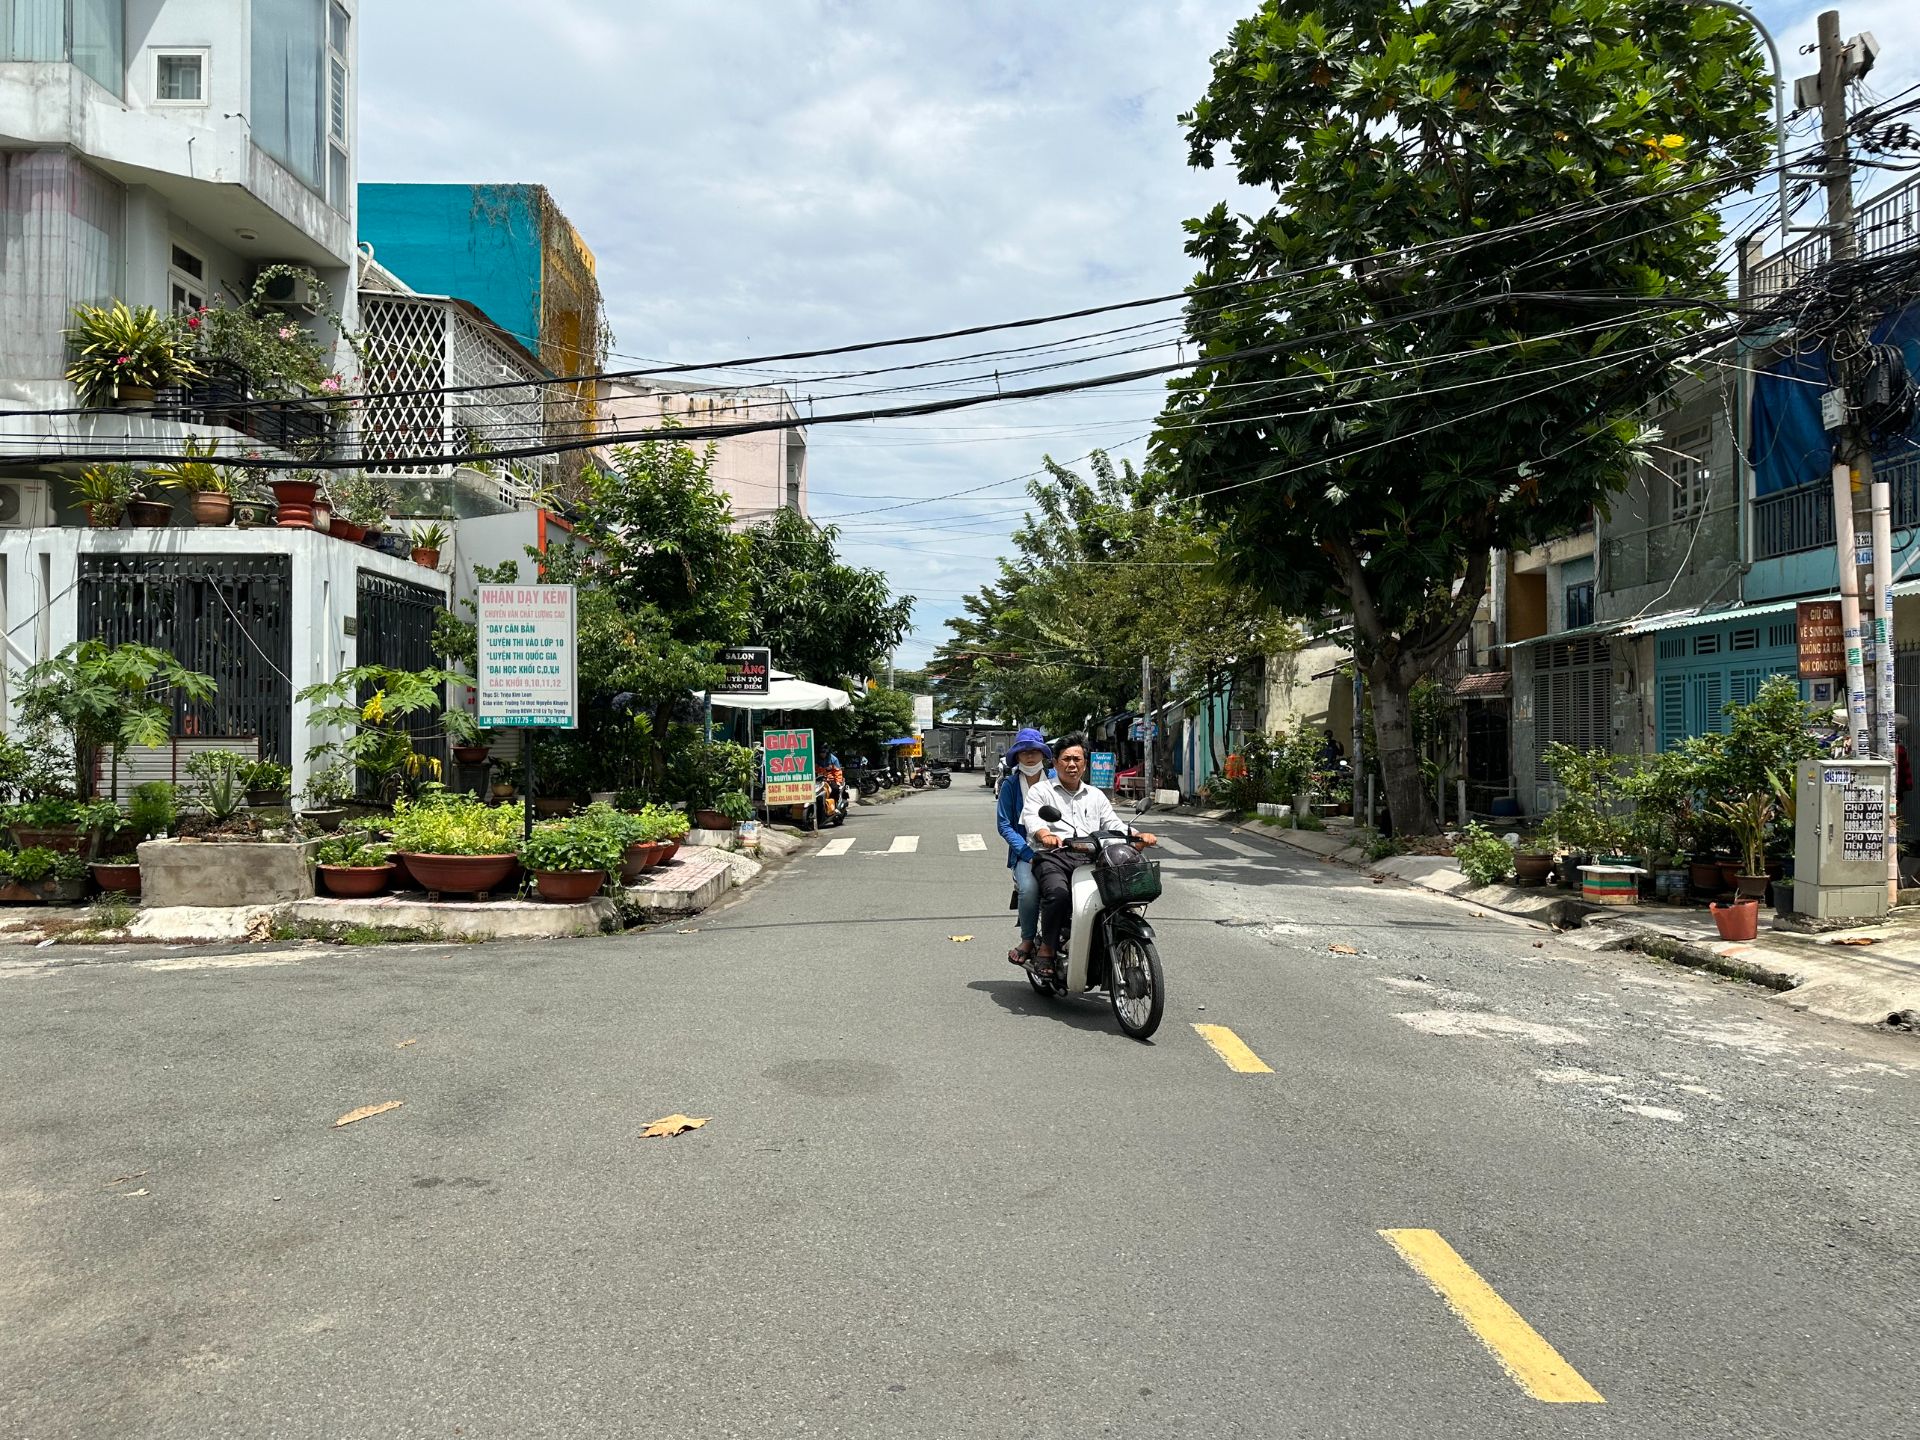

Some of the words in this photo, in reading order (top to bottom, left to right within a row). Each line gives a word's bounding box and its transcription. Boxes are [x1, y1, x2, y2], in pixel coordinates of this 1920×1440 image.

[482, 588, 514, 607] NHẬN
[517, 590, 539, 607] DẠY
[1822, 606, 1833, 620] GÌN
[1809, 626, 1823, 637] SINH
[1824, 625, 1844, 637] CHUN
[512, 638, 524, 647] THI
[540, 637, 553, 647] LỚP
[556, 638, 564, 647] 10
[1800, 641, 1821, 654] KHÔNG
[512, 652, 524, 660] THI
[525, 650, 544, 661] QUỐC
[545, 652, 557, 660] GIA
[725, 652, 755, 660] SALON
[503, 665, 517, 676] HỌC
[519, 663, 535, 674] KHỐI
[1812, 657, 1829, 671] CÔNG
[489, 677, 504, 687] CÁC
[505, 677, 523, 688] KHỐI
[765, 730, 810, 752] GIẶT
[769, 753, 807, 773] SẤY
[1866, 811, 1882, 819] GÓP
[1845, 833, 1863, 841] CHO
[1866, 833, 1883, 841] VAY
[1865, 841, 1882, 849] GÓP
